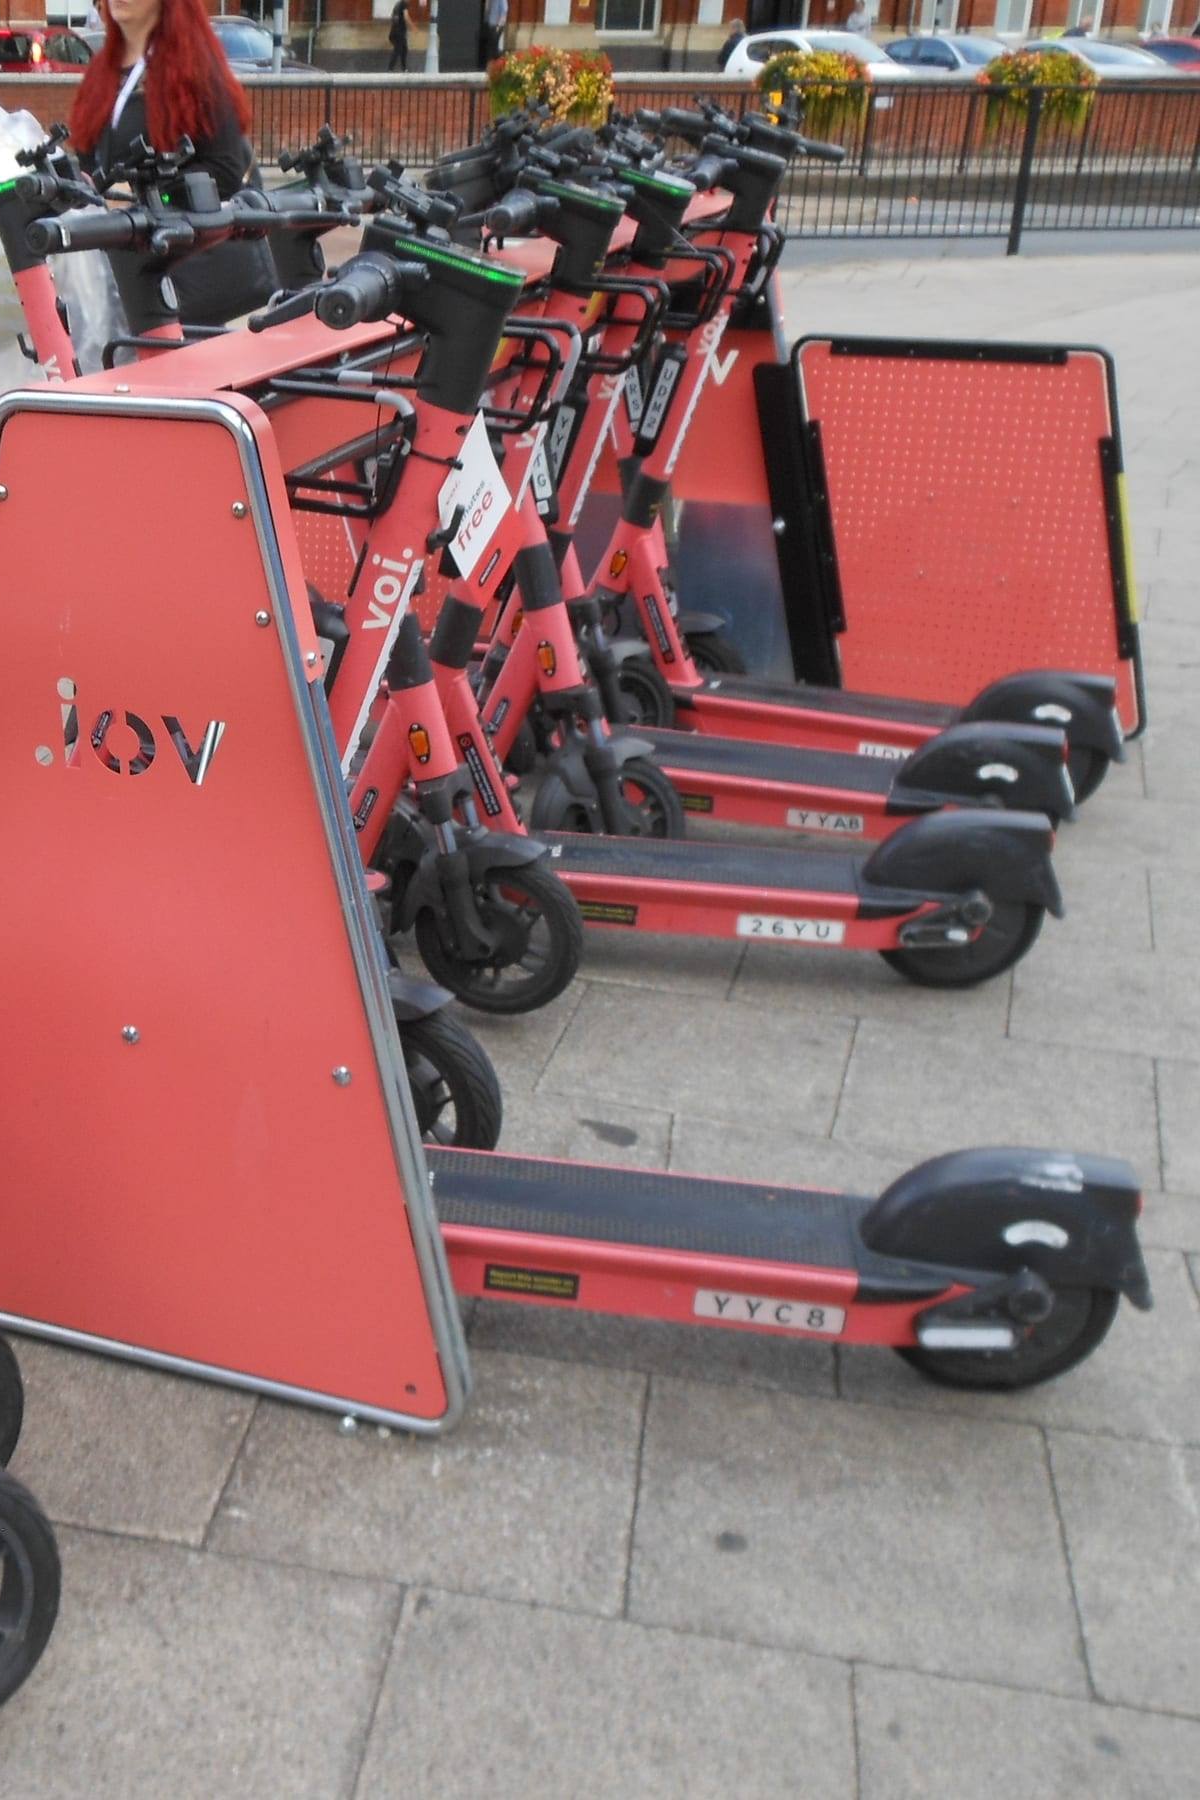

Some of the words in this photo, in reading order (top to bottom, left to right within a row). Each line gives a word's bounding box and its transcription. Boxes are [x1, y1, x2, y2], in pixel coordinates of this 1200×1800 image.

[456, 490, 494, 551] free
[361, 547, 413, 630] voi.
[751, 918, 831, 939] 26YU
[713, 1295, 826, 1329] YYC8
